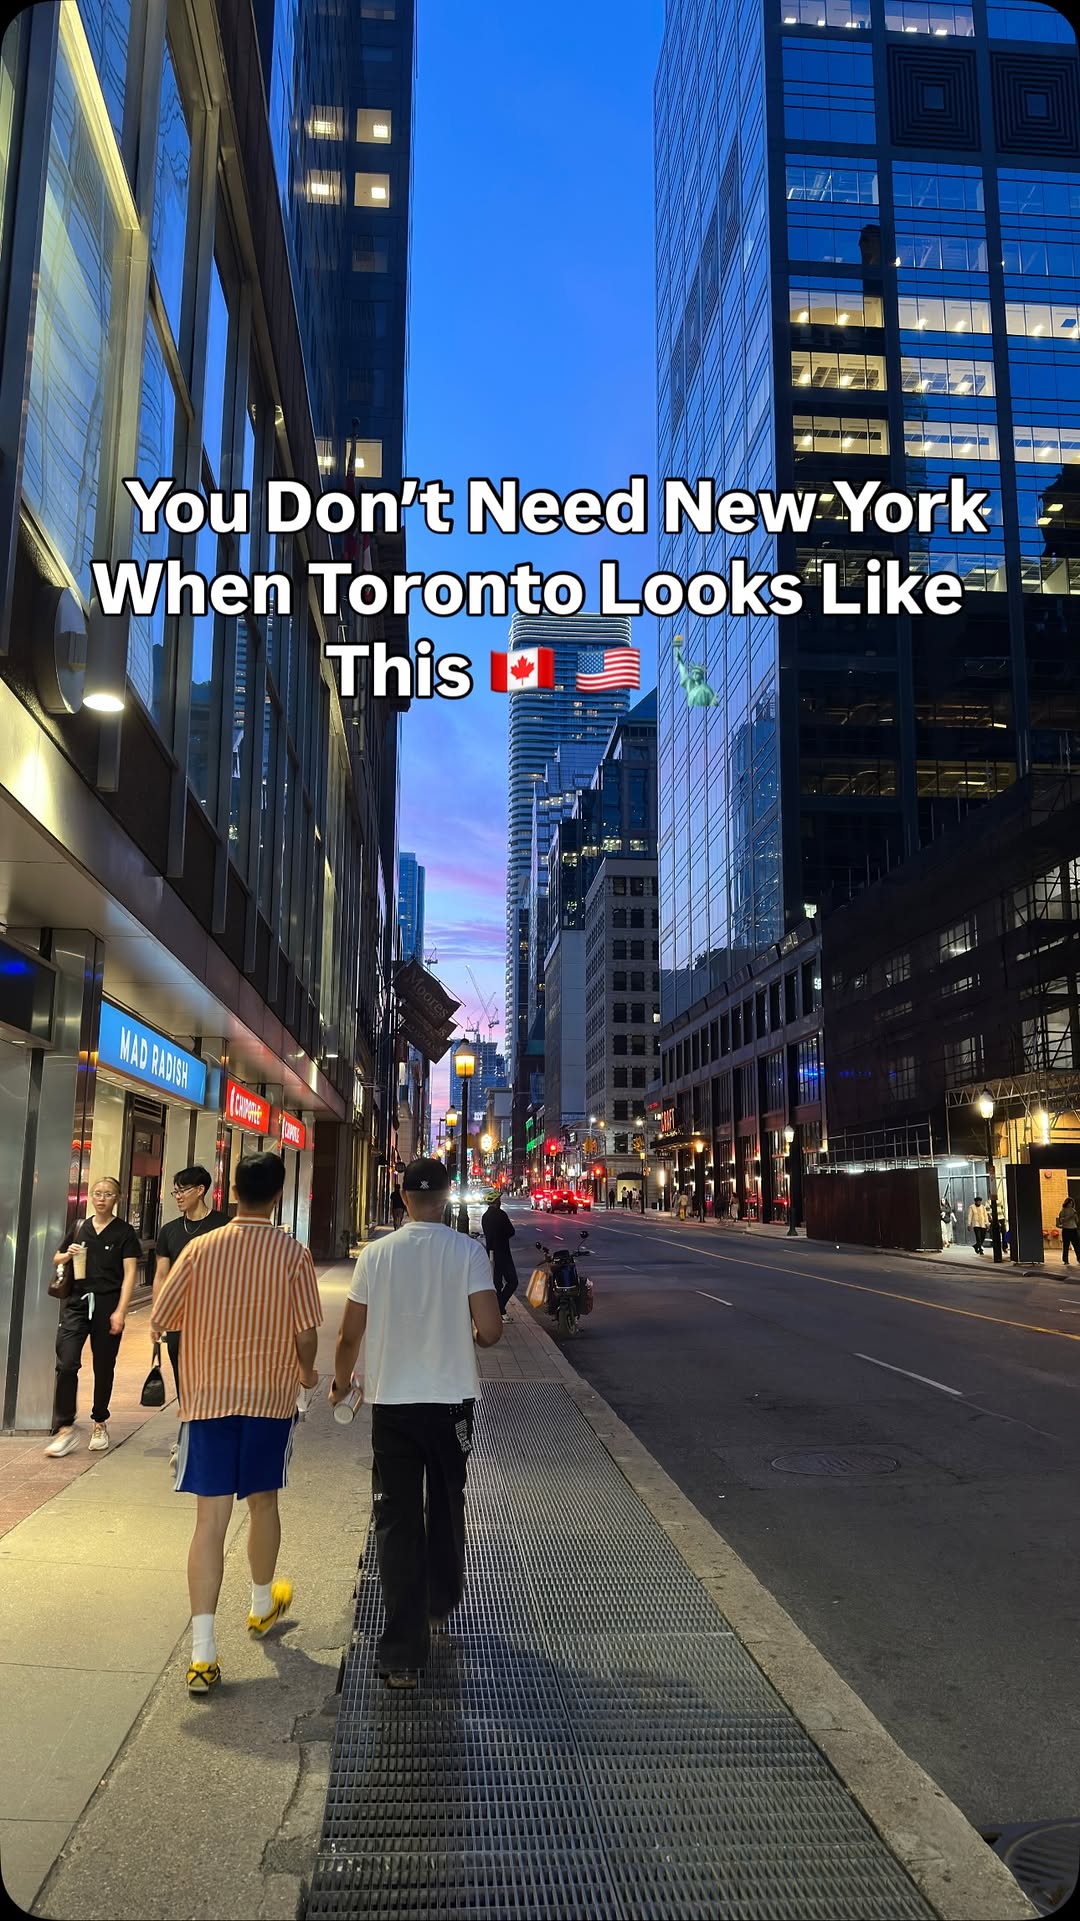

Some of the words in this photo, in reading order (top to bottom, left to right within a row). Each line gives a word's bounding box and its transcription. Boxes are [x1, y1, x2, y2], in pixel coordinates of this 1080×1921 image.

[404, 969, 449, 1018] Moores
[119, 1026, 147, 1071] MAD
[151, 1043, 189, 1089] RADISH
[234, 1092, 262, 1125] CHIPOTLE
